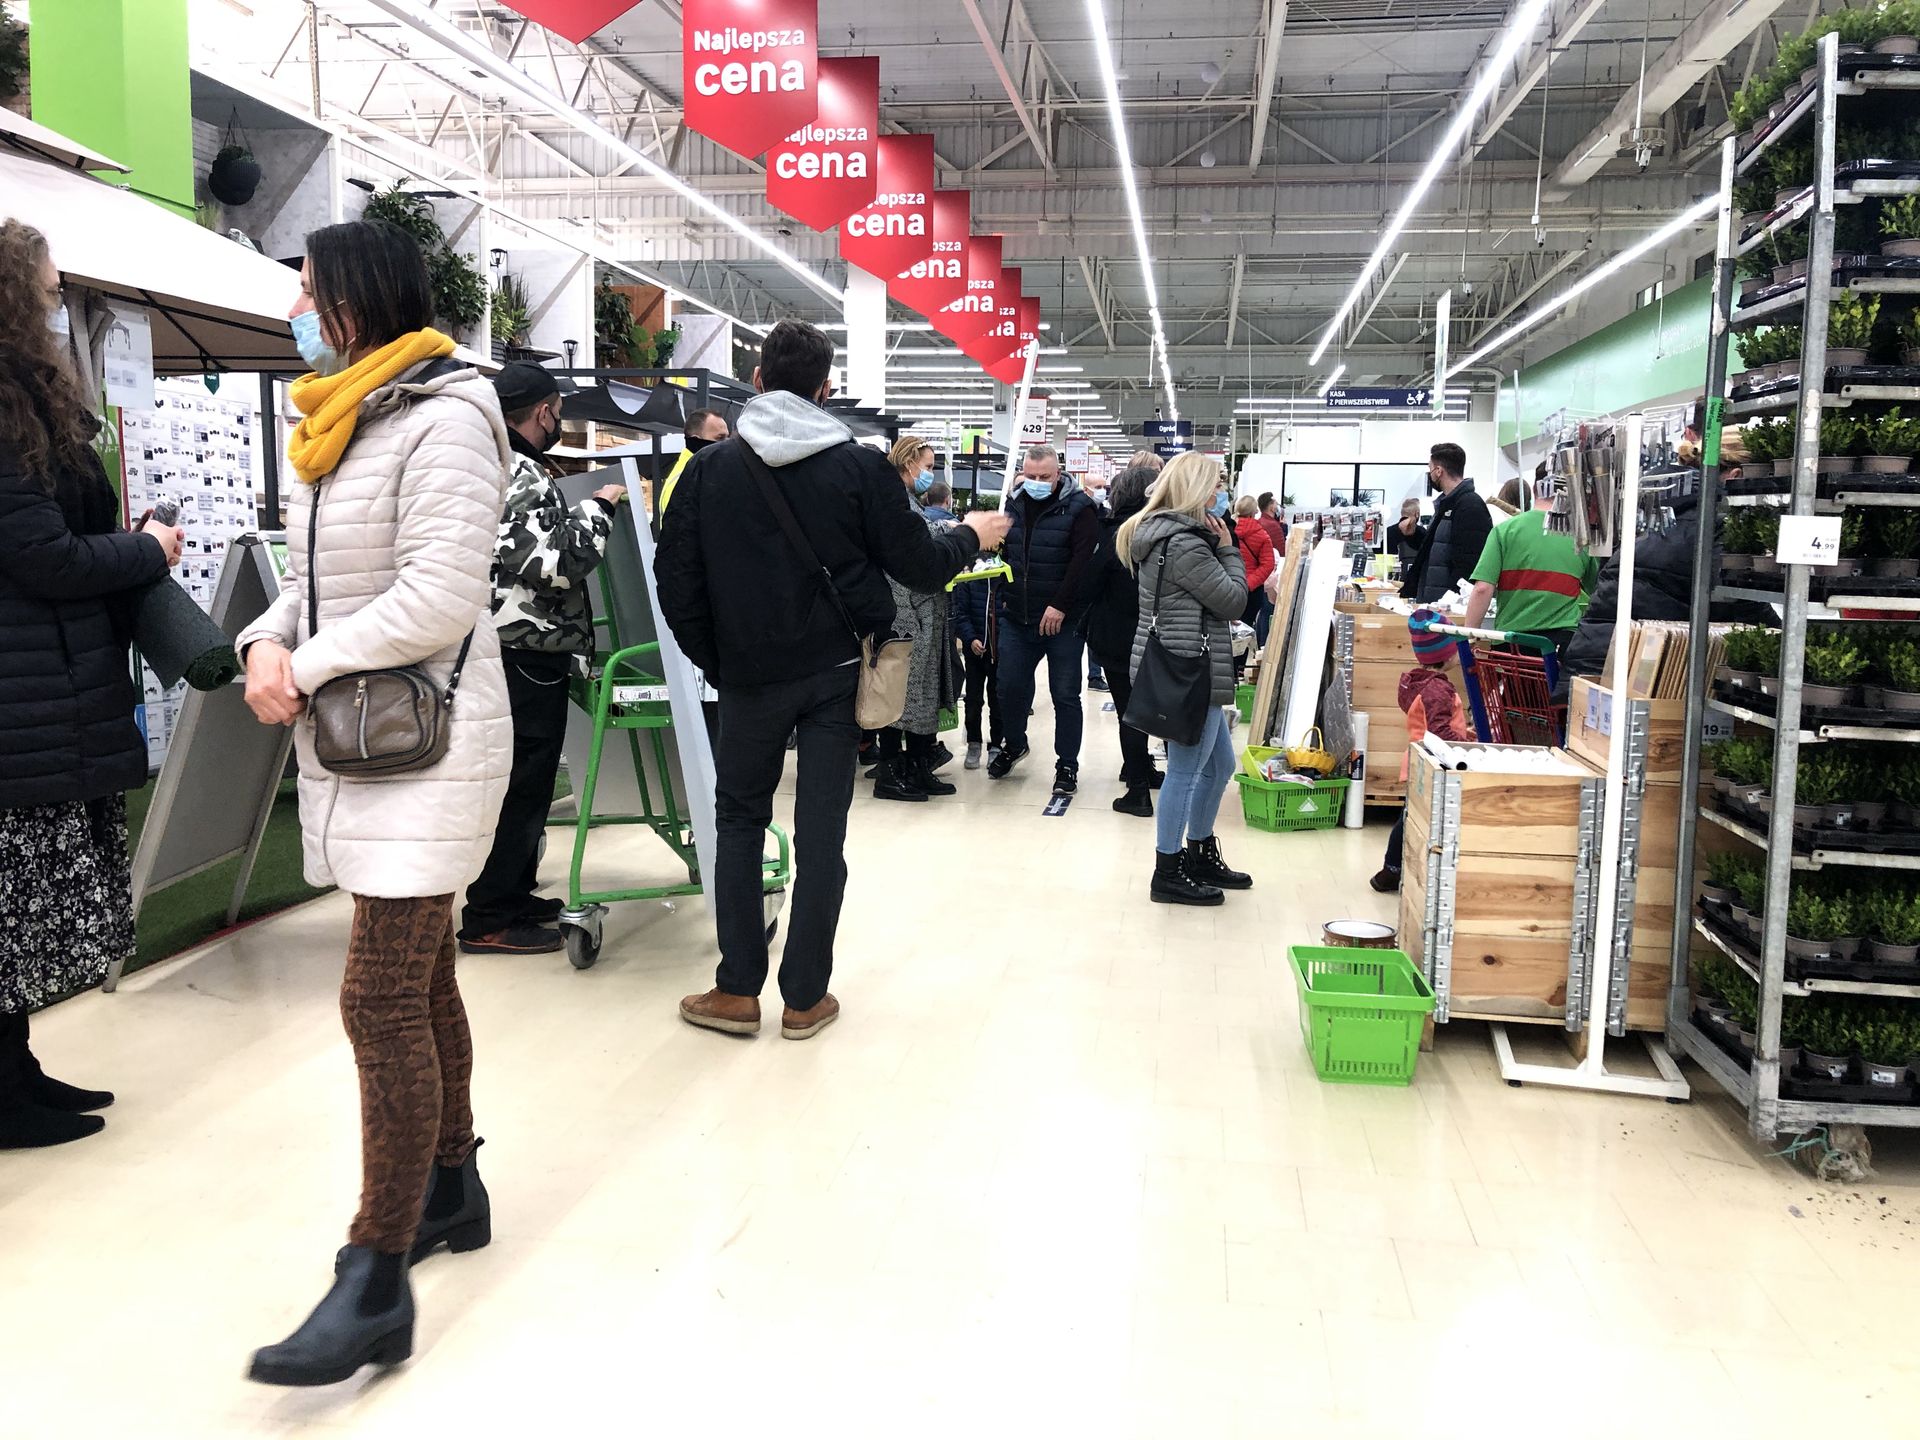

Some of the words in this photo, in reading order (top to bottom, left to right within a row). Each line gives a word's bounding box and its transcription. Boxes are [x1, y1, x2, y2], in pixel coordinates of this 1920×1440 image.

[693, 27, 806, 55] Najlepsza
[694, 59, 806, 96] cena
[784, 123, 868, 146] ajlepsza
[775, 151, 868, 179] cena
[847, 213, 926, 237] cena
[939, 295, 995, 313] ena
[1329, 390, 1346, 398] KASA
[1334, 397, 1390, 406] PIERWSZEŃSTWEM
[1022, 424, 1042, 433] 429
[1069, 458, 1086, 466] 1697
